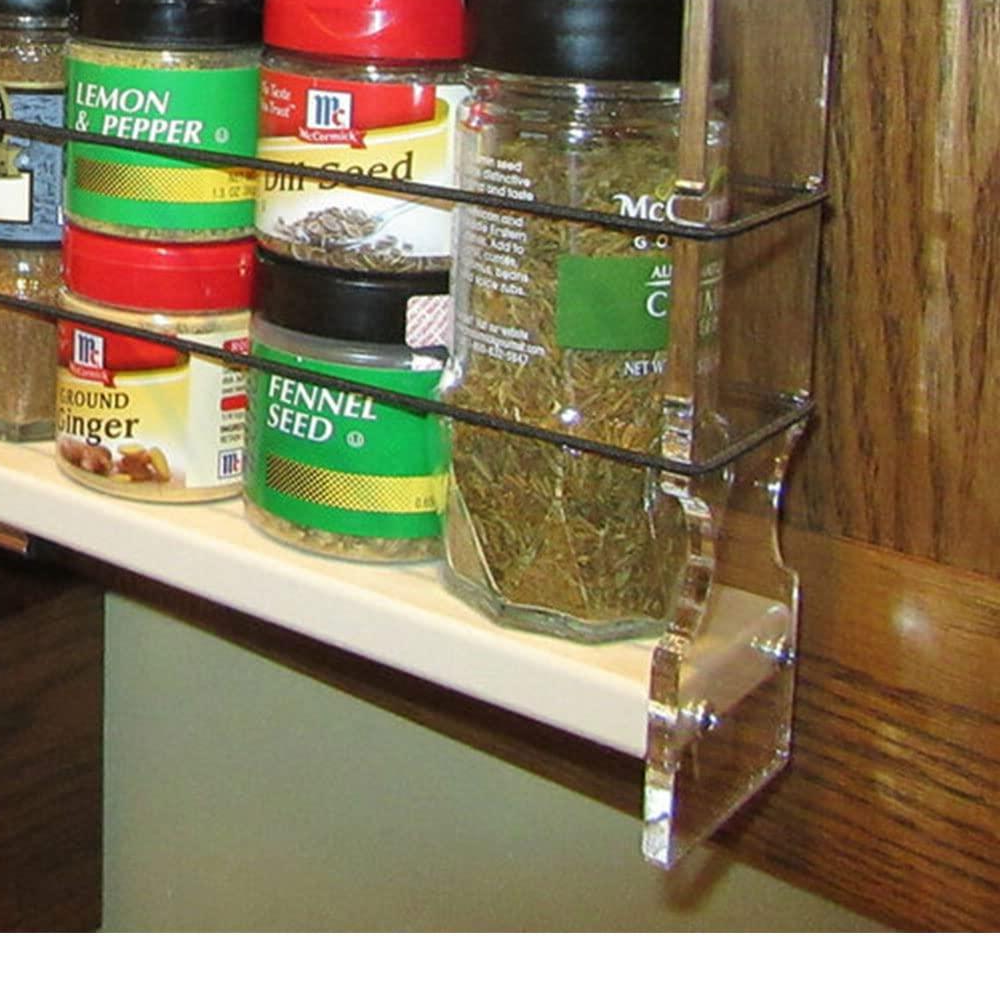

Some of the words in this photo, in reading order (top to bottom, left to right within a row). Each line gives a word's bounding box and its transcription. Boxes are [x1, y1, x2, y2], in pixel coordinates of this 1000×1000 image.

[75, 81, 170, 115] LEMON
[74, 109, 90, 133] &
[101, 114, 204, 145] PEPPER
[299, 127, 358, 143] McCormick
[623, 360, 650, 376] NET
[268, 375, 377, 420] FENNEL
[266, 403, 333, 443] SEED
